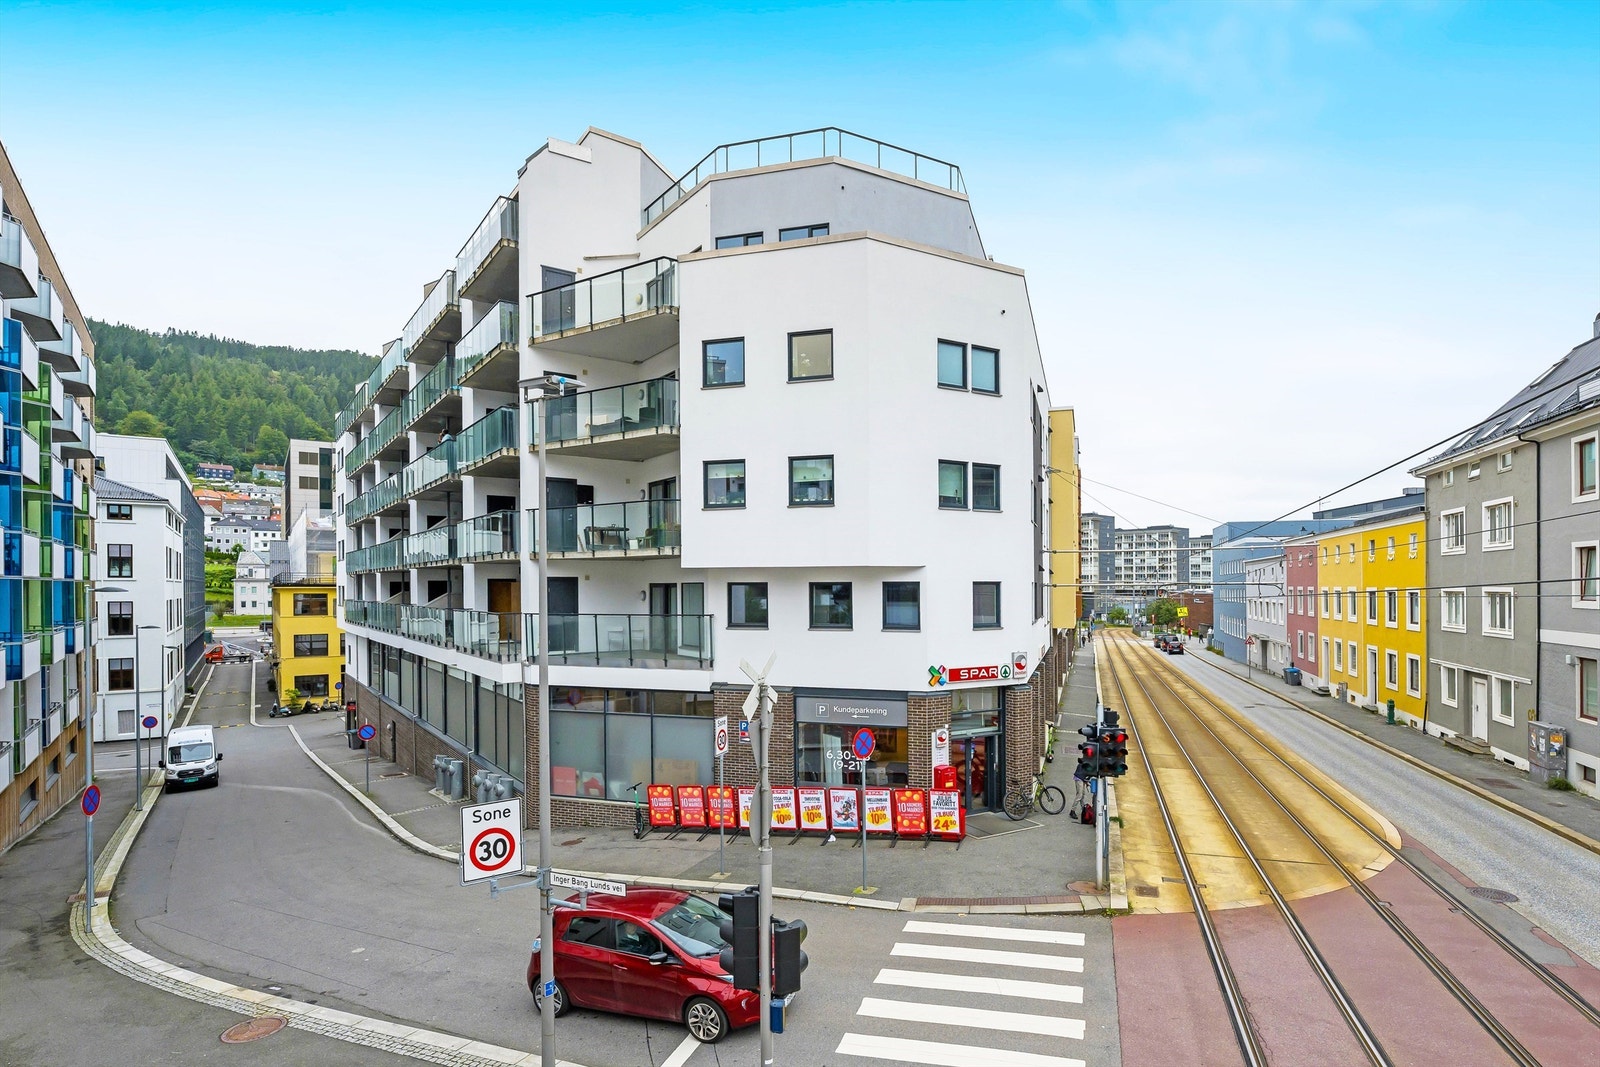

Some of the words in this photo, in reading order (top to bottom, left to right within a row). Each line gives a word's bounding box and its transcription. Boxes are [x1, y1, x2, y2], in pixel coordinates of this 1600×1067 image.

[960, 667, 998, 679] SPAR
[819, 706, 826, 715] P
[833, 706, 888, 716] Kundeparkering
[741, 722, 747, 730] P
[897, 802, 906, 813] 10
[472, 807, 511, 824] Sone
[479, 837, 508, 862] 30
[553, 874, 570, 885] Inger
[571, 877, 588, 889] Bang
[590, 880, 610, 891] Lunds
[612, 884, 623, 893] vei
